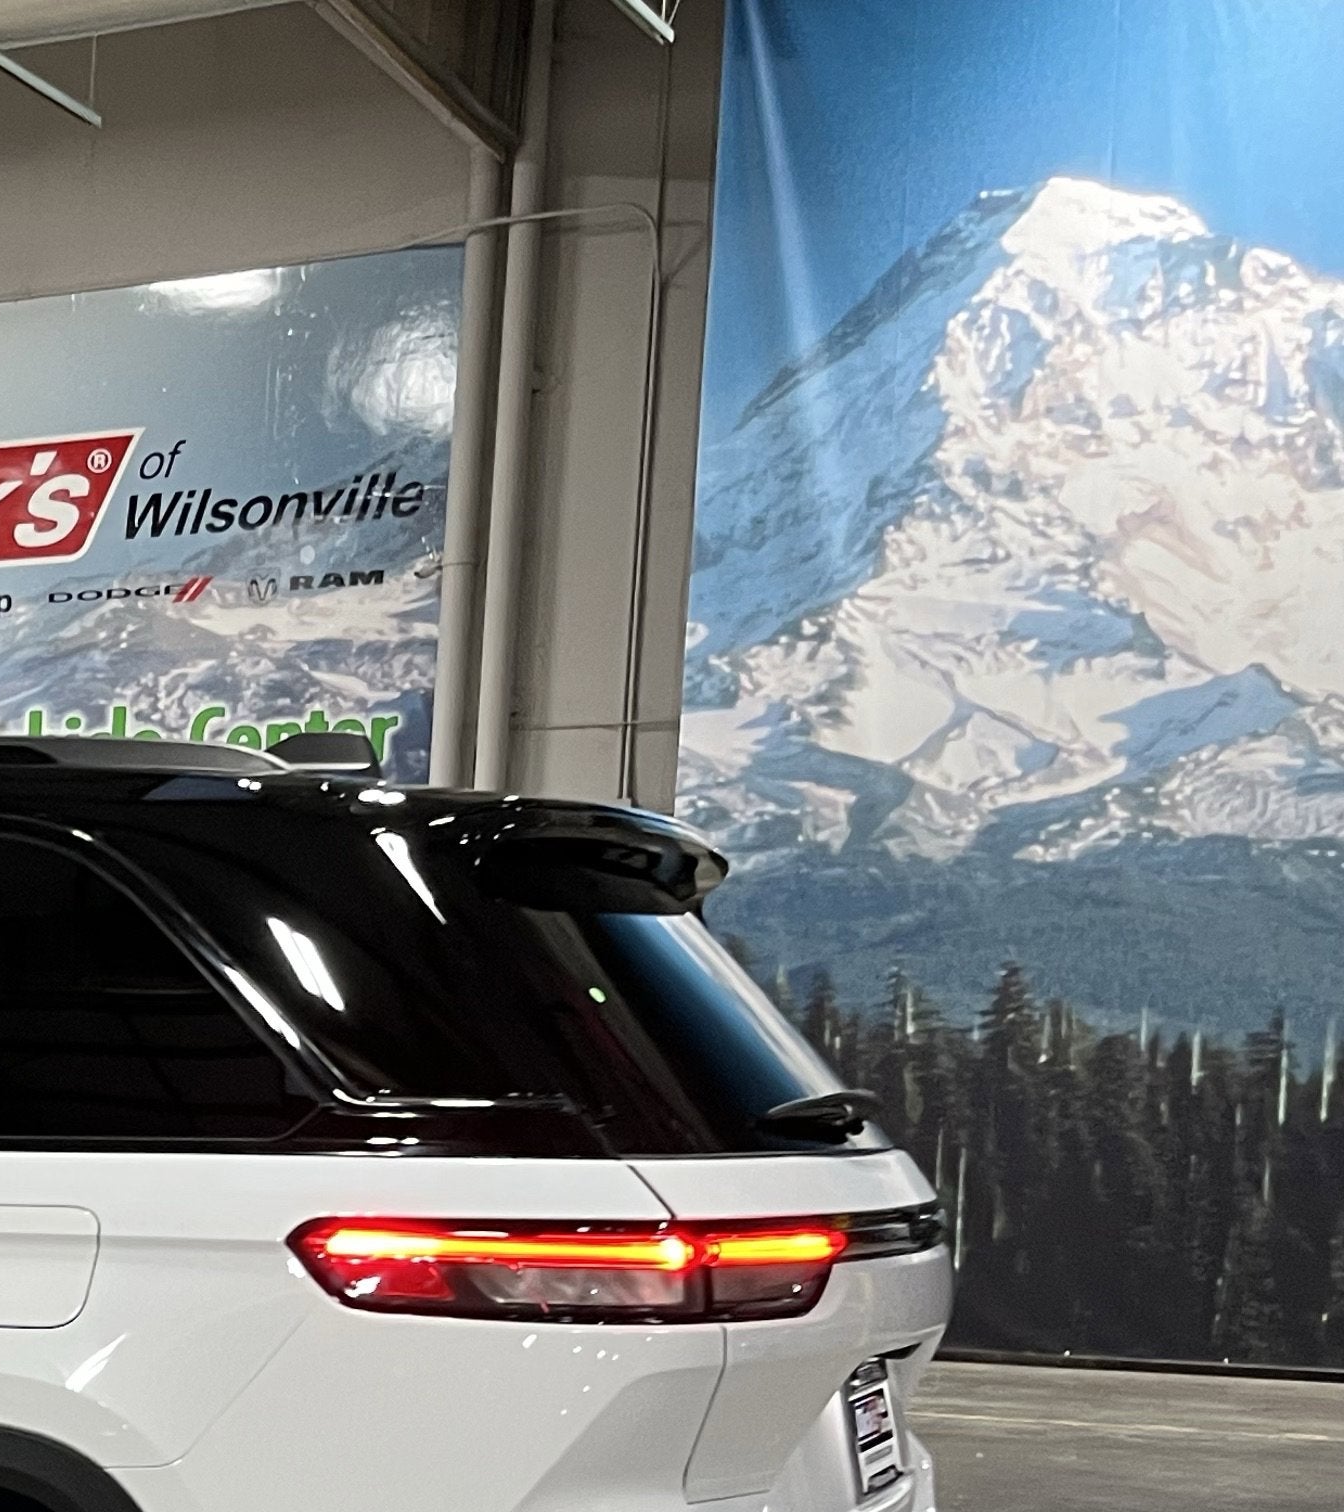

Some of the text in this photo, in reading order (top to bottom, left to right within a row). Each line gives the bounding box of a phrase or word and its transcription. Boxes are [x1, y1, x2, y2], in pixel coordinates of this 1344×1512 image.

[139, 441, 186, 480] of
[124, 471, 425, 541] Wilsonville
[289, 569, 385, 592] RAM
